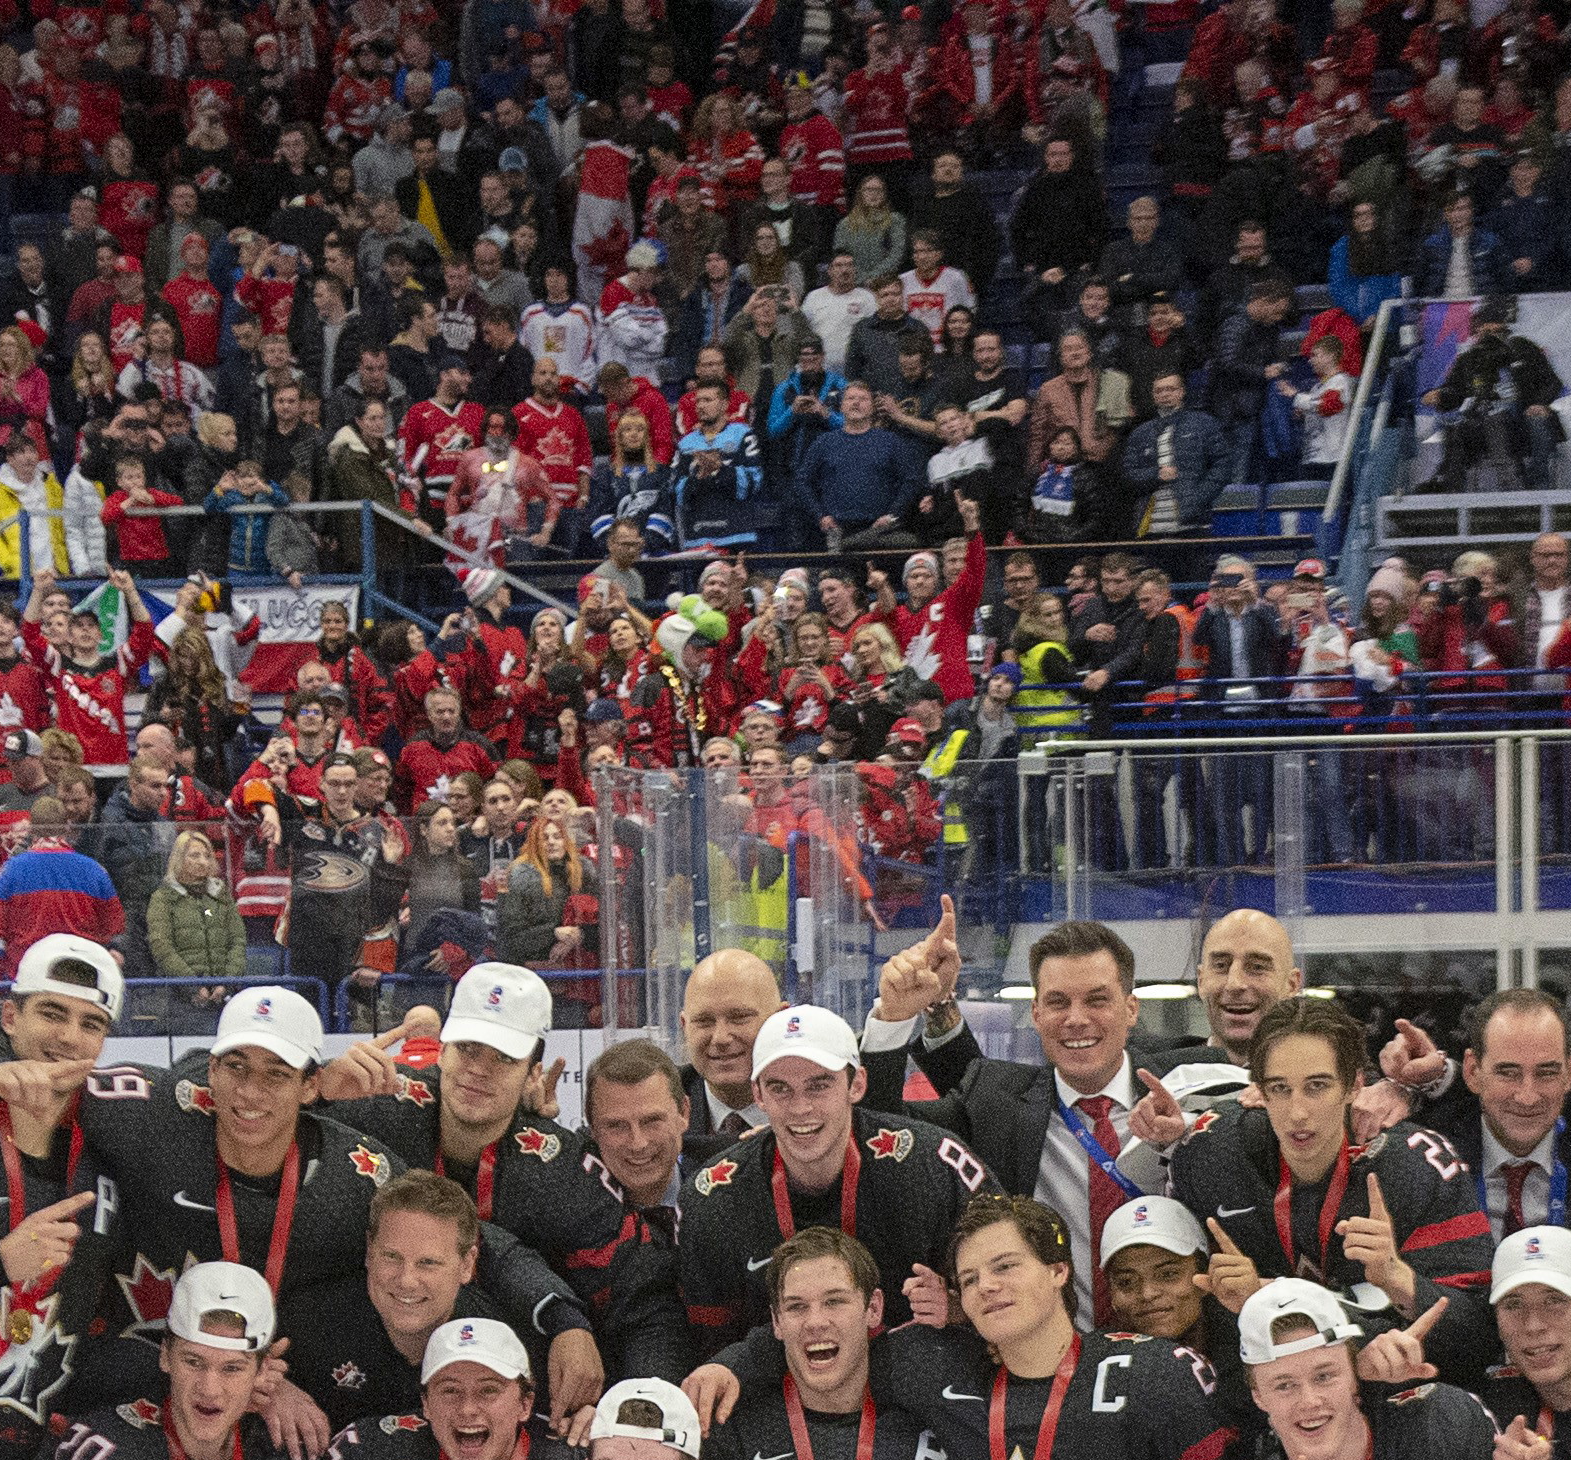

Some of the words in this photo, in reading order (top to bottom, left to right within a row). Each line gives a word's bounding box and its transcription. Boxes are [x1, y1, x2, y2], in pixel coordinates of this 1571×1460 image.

[929, 603, 945, 621] C
[936, 1137, 986, 1192] 8
[1092, 1356, 1130, 1413] C
